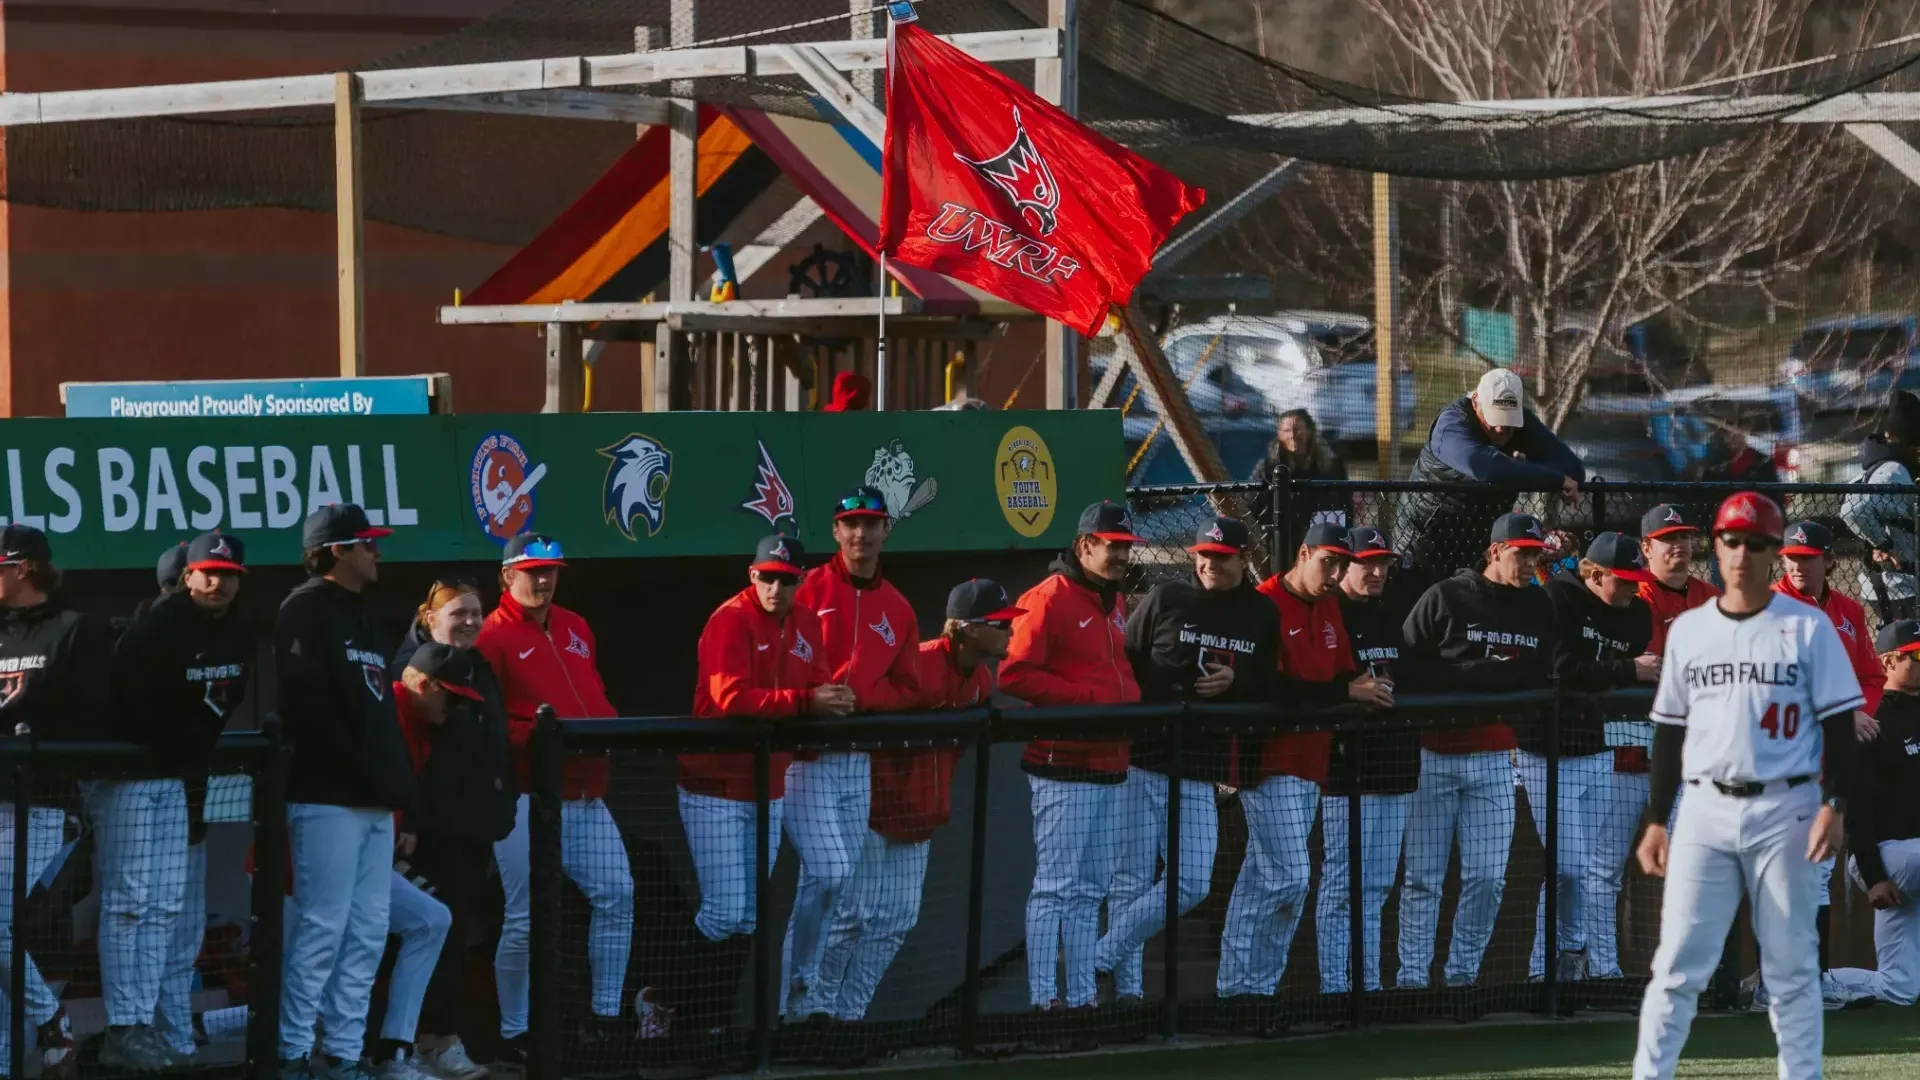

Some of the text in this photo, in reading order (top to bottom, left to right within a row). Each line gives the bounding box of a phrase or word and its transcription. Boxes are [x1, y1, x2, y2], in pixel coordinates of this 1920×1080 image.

[927, 202, 1081, 283] UWRF
[110, 391, 373, 417] Playground Proudly Sponsored By
[500, 434, 528, 469] FISH
[0, 444, 418, 533] LS BASEBALL
[1012, 481, 1040, 493] YOUTH
[1007, 495, 1049, 508] BASEBALL
[1180, 630, 1256, 654] UW-RIVER FALLS
[1467, 630, 1512, 645] UW-RIVER
[1739, 662, 1798, 687] FALLS
[1760, 702, 1799, 740] 40
